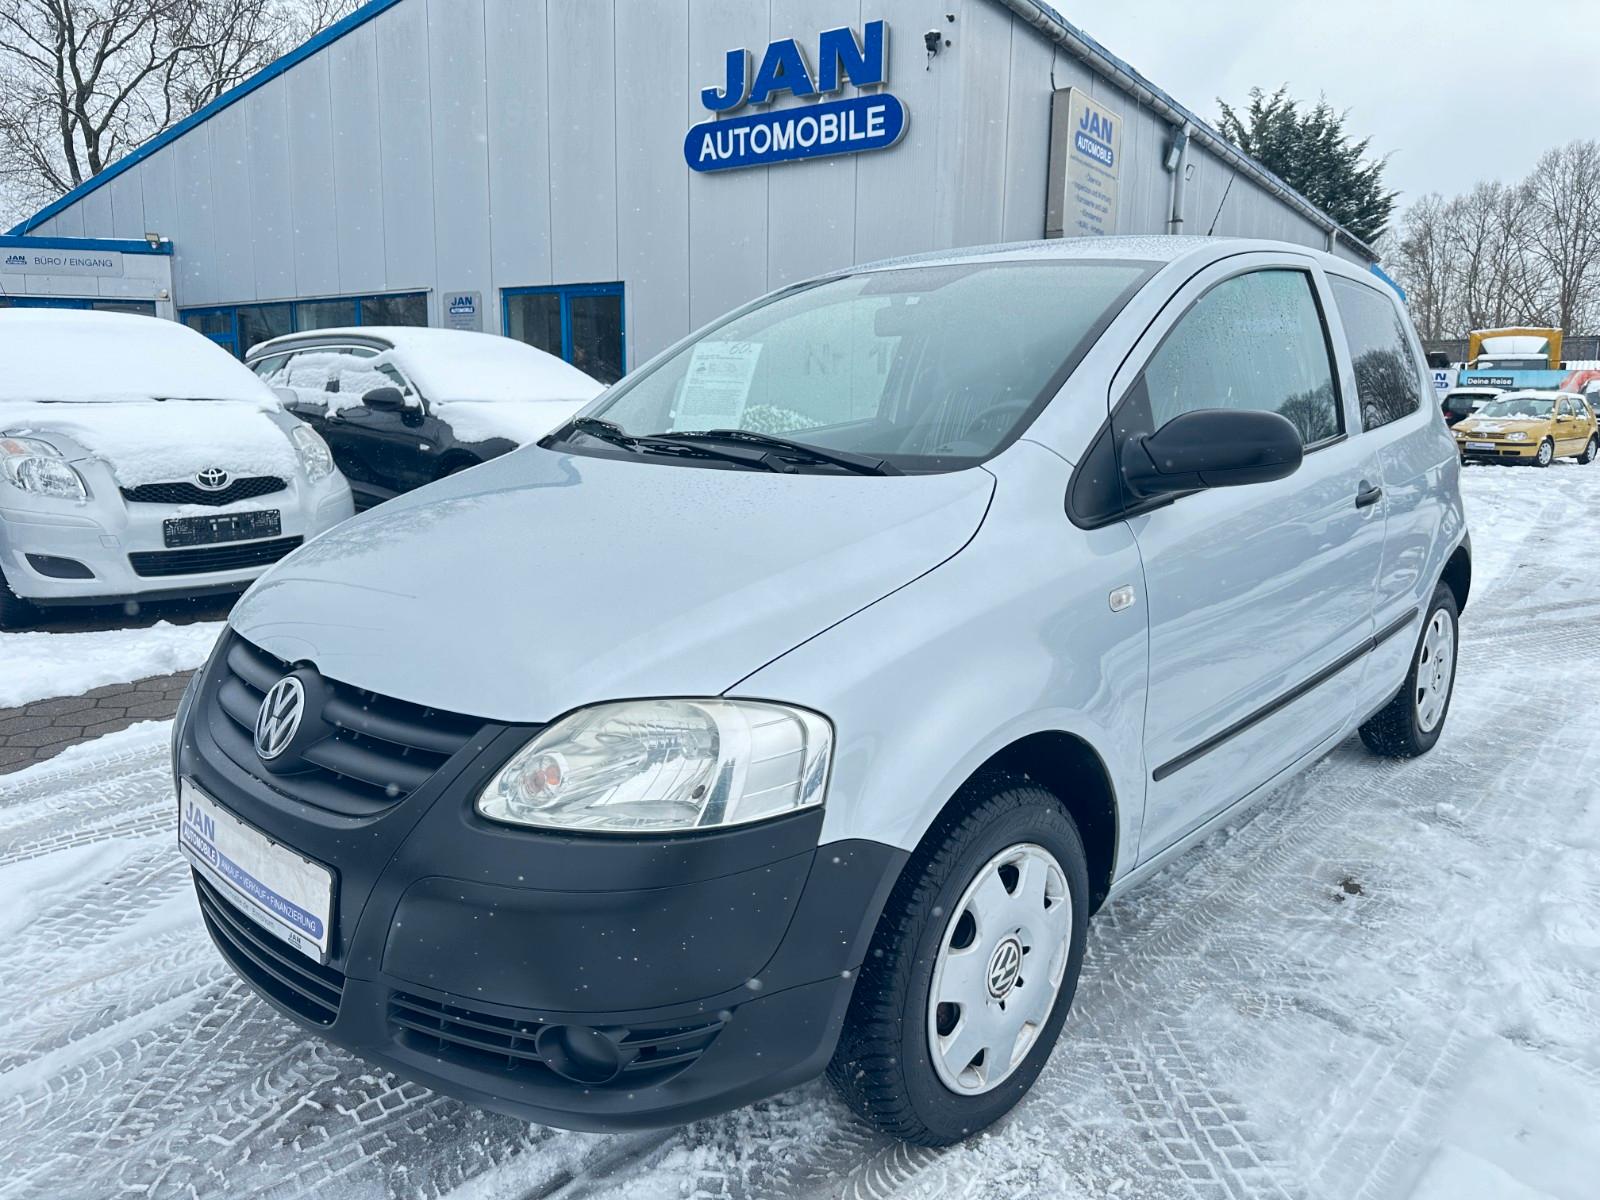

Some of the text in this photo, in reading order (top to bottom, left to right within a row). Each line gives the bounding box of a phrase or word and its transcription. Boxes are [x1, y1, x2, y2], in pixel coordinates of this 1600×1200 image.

[701, 19, 888, 112] JAN
[699, 105, 886, 162] AUTOMOBILE
[1080, 107, 1113, 144] JAN
[1077, 135, 1112, 164] AUTOMOBILE
[34, 256, 61, 265] BÜRO
[69, 258, 113, 267] EINGANG
[451, 296, 473, 306] JAN
[185, 801, 215, 842] JAN
[183, 827, 217, 863] AUTOMOBILE
[243, 875, 267, 898] VERKAUF
[270, 895, 316, 932] FINANZIERUNG
